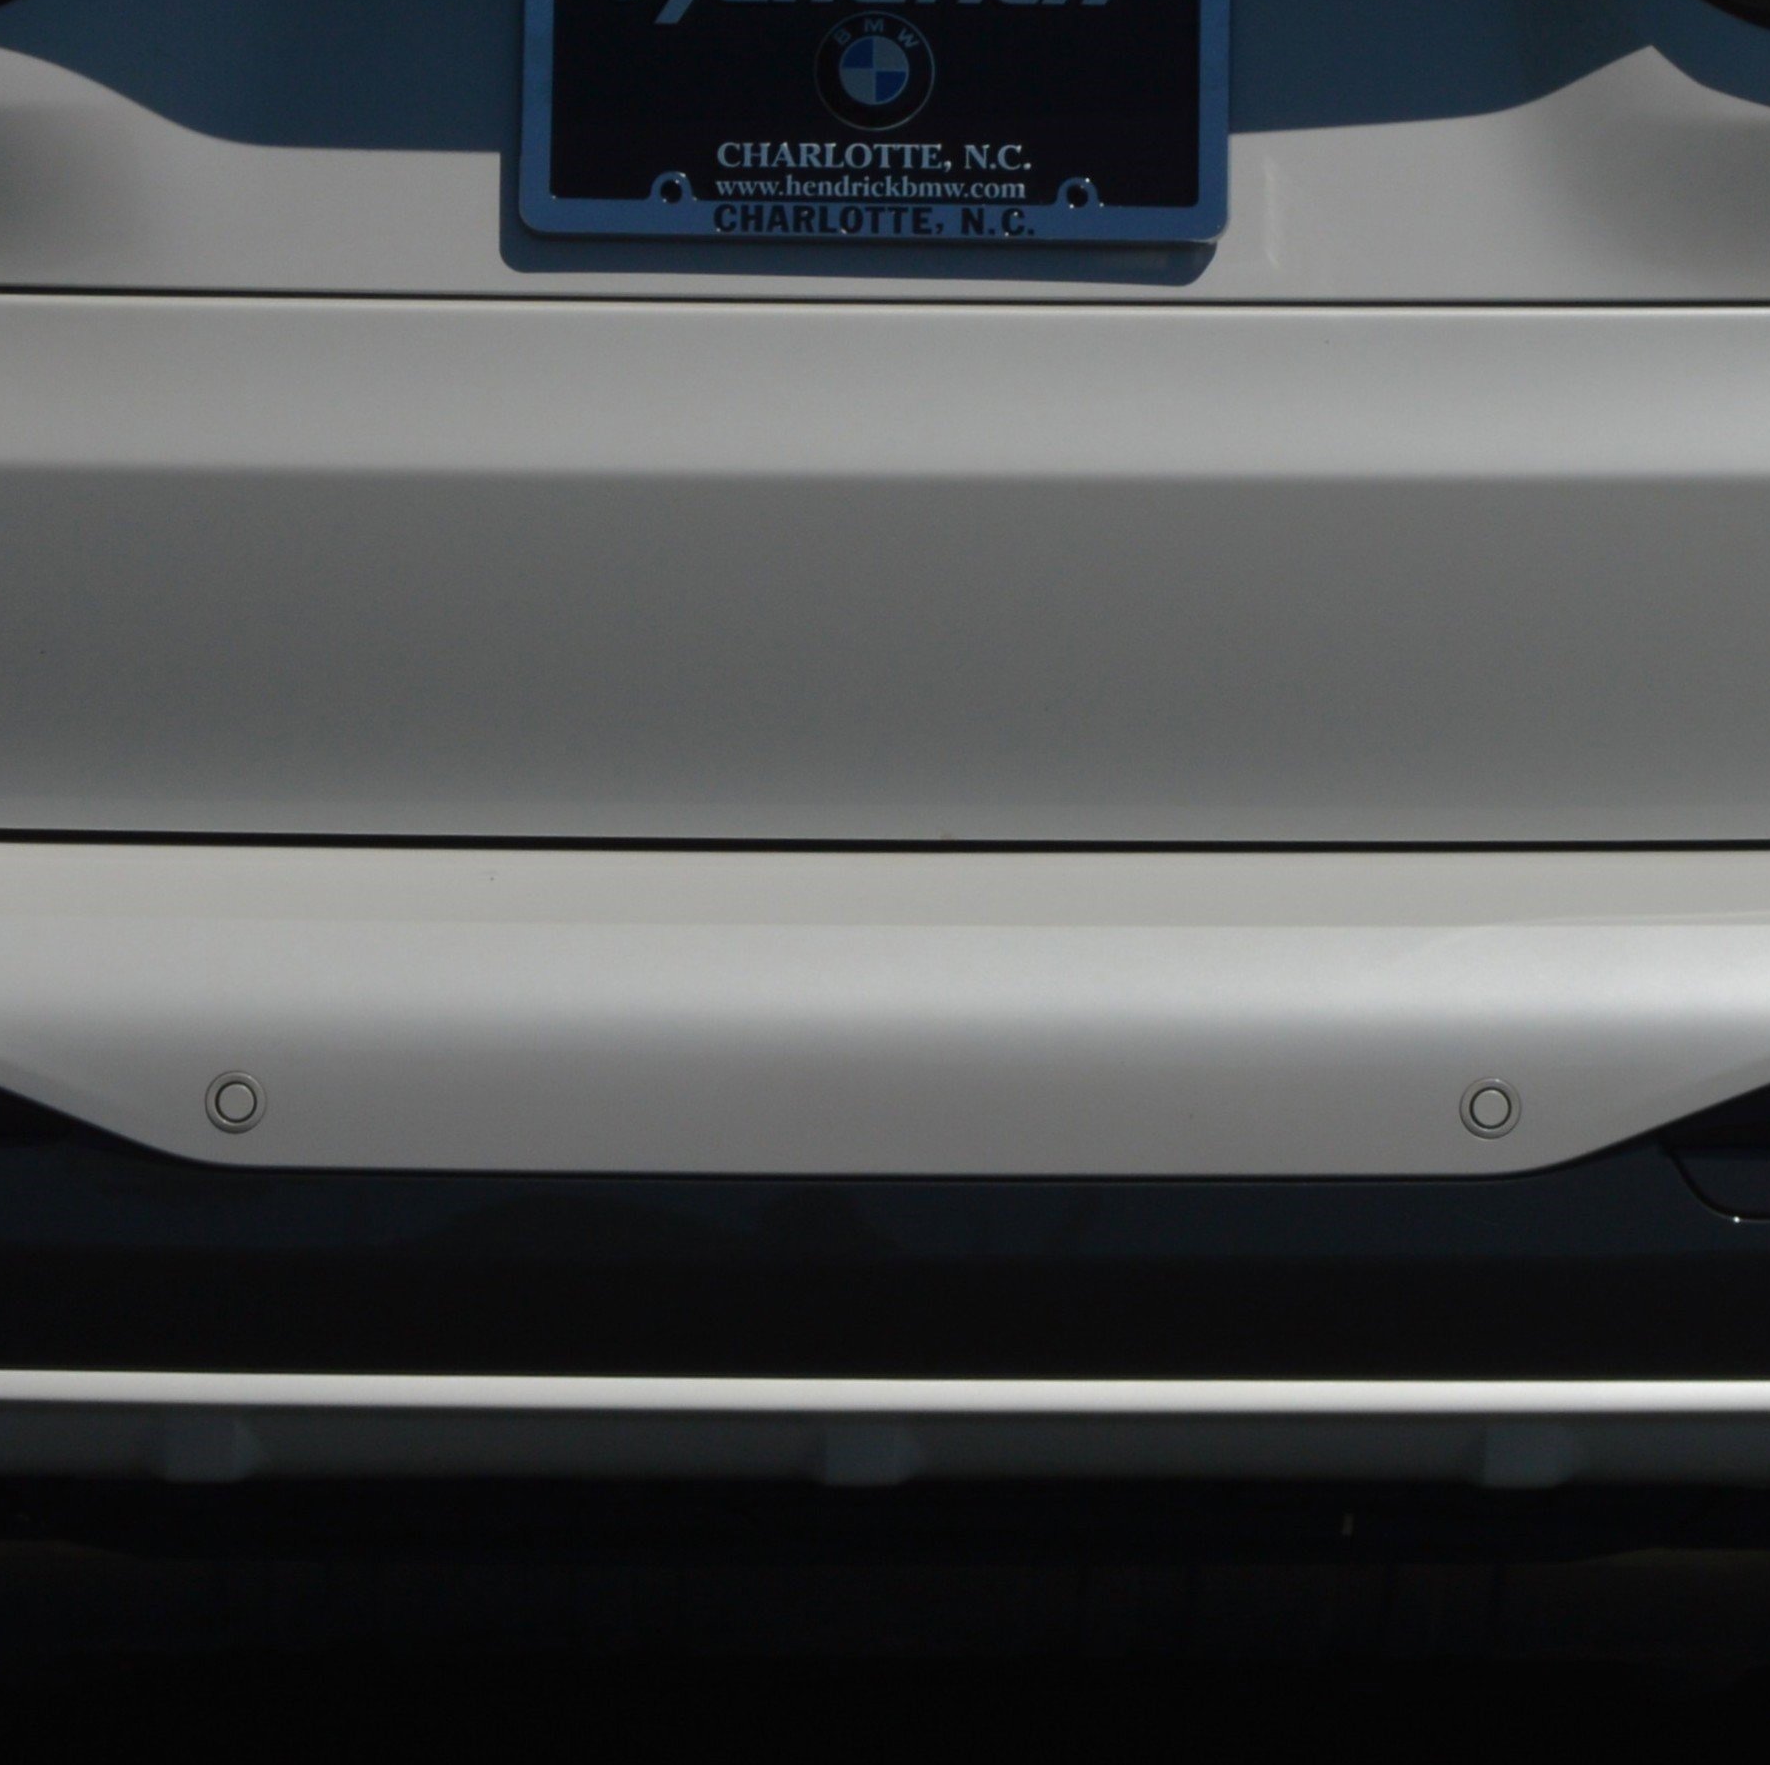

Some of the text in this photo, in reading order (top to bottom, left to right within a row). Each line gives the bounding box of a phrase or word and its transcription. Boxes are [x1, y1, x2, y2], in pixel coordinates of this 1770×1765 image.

[831, 17, 920, 48] BMW
[716, 141, 1032, 173] CHARLOTTE, N.C.
[714, 173, 1027, 200] www.hendrickbmw.com
[713, 204, 1035, 236] CHARLOTTE, N.C.
